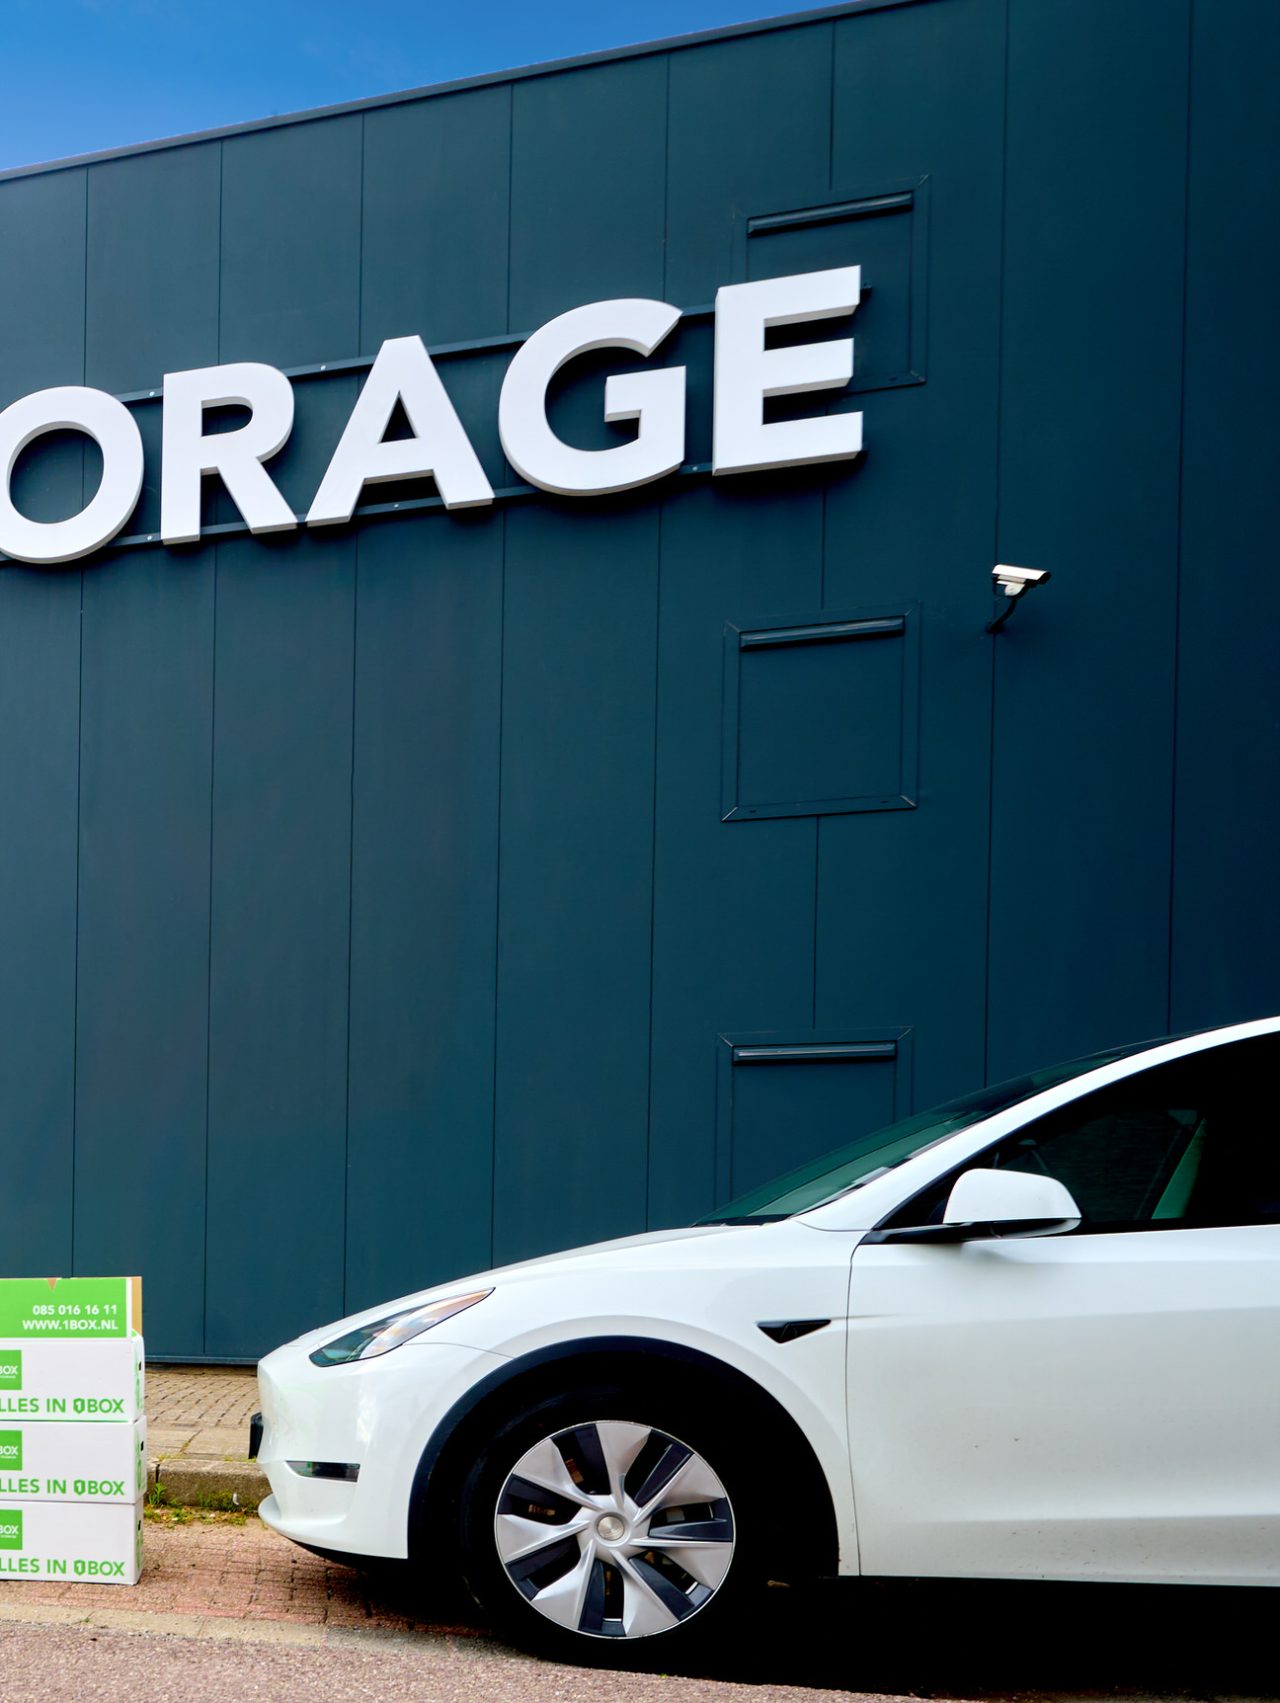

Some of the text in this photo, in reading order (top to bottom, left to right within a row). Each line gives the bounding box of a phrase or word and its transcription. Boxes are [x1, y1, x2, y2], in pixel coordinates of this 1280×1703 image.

[32, 1304, 117, 1316] 085 016 16 11
[22, 1319, 119, 1331] WWW.1BOX.NL
[46, 1399, 67, 1414] IN
[46, 1479, 67, 1494] IN
[46, 1558, 67, 1574] IN
